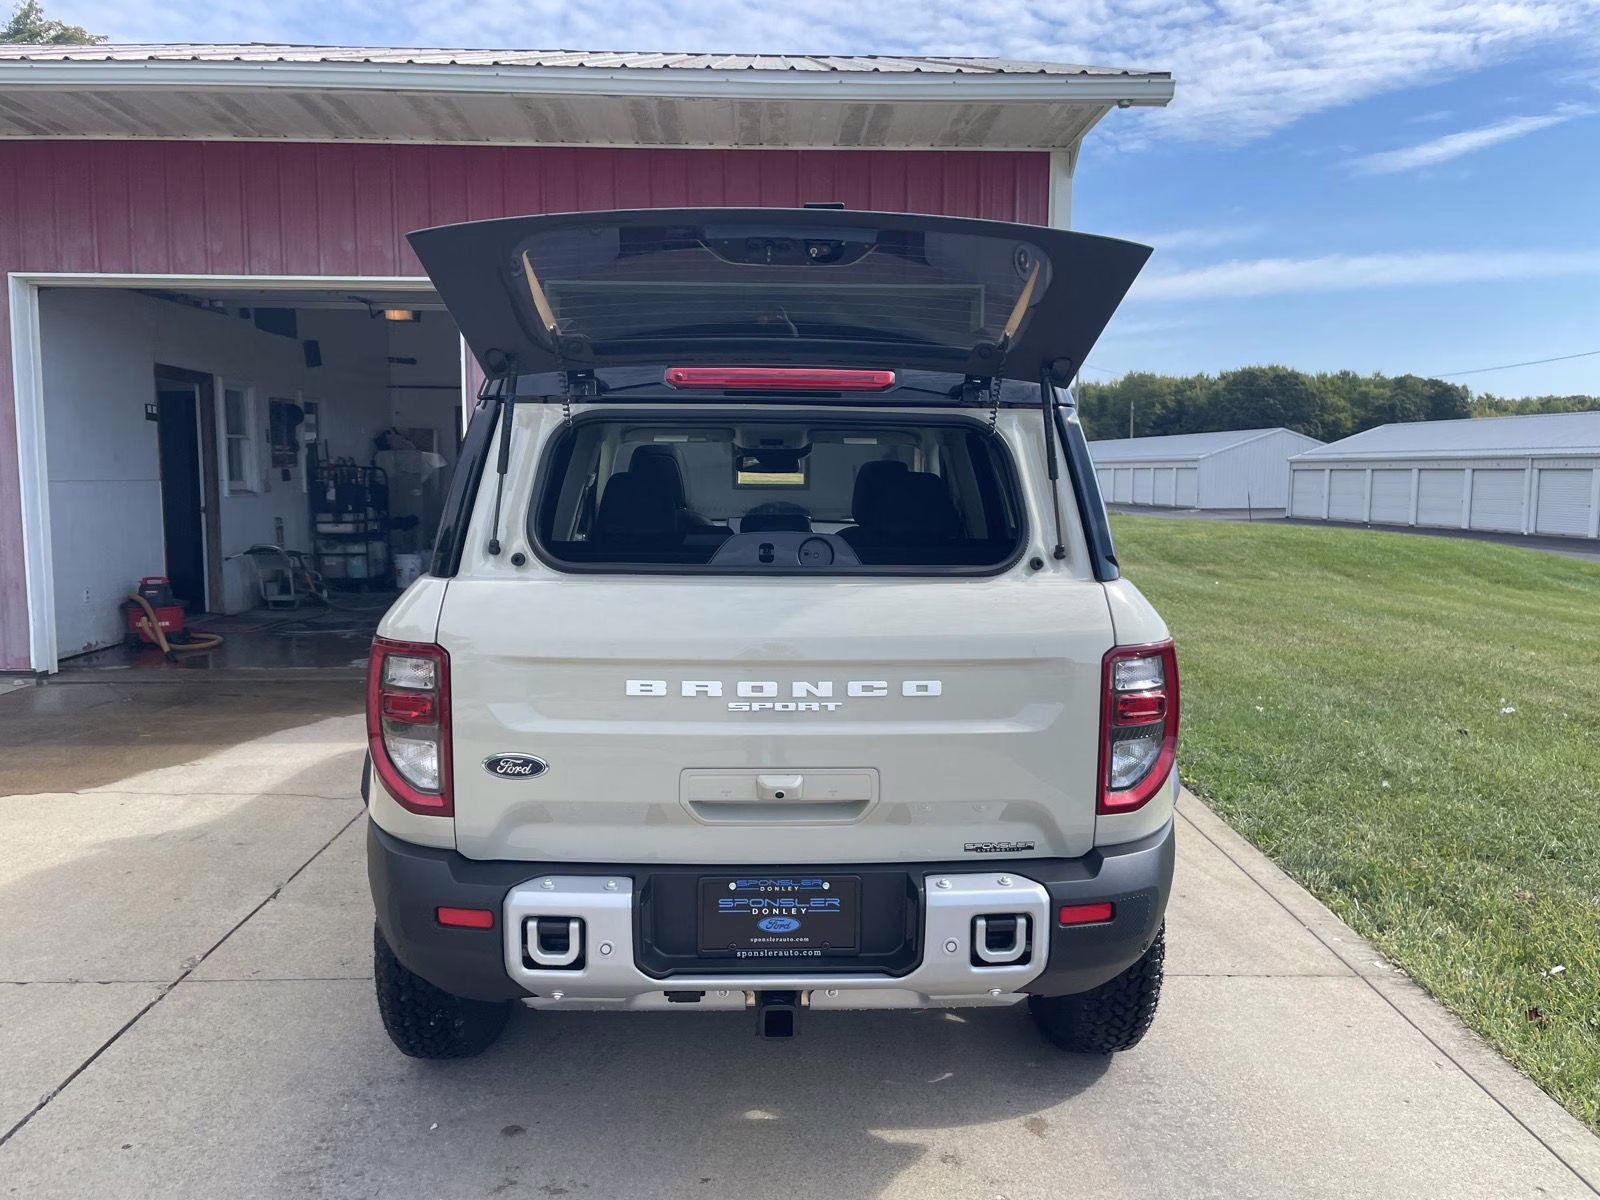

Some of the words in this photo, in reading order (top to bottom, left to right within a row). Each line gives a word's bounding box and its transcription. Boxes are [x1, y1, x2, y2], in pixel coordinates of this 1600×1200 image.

[625, 679, 942, 697] BRONCO
[727, 702, 843, 712] SPORT
[496, 758, 533, 774] Ford
[964, 841, 1035, 850] SPONSLER
[718, 898, 840, 907] SPONSLER
[736, 950, 821, 958] sponslerauto.com
